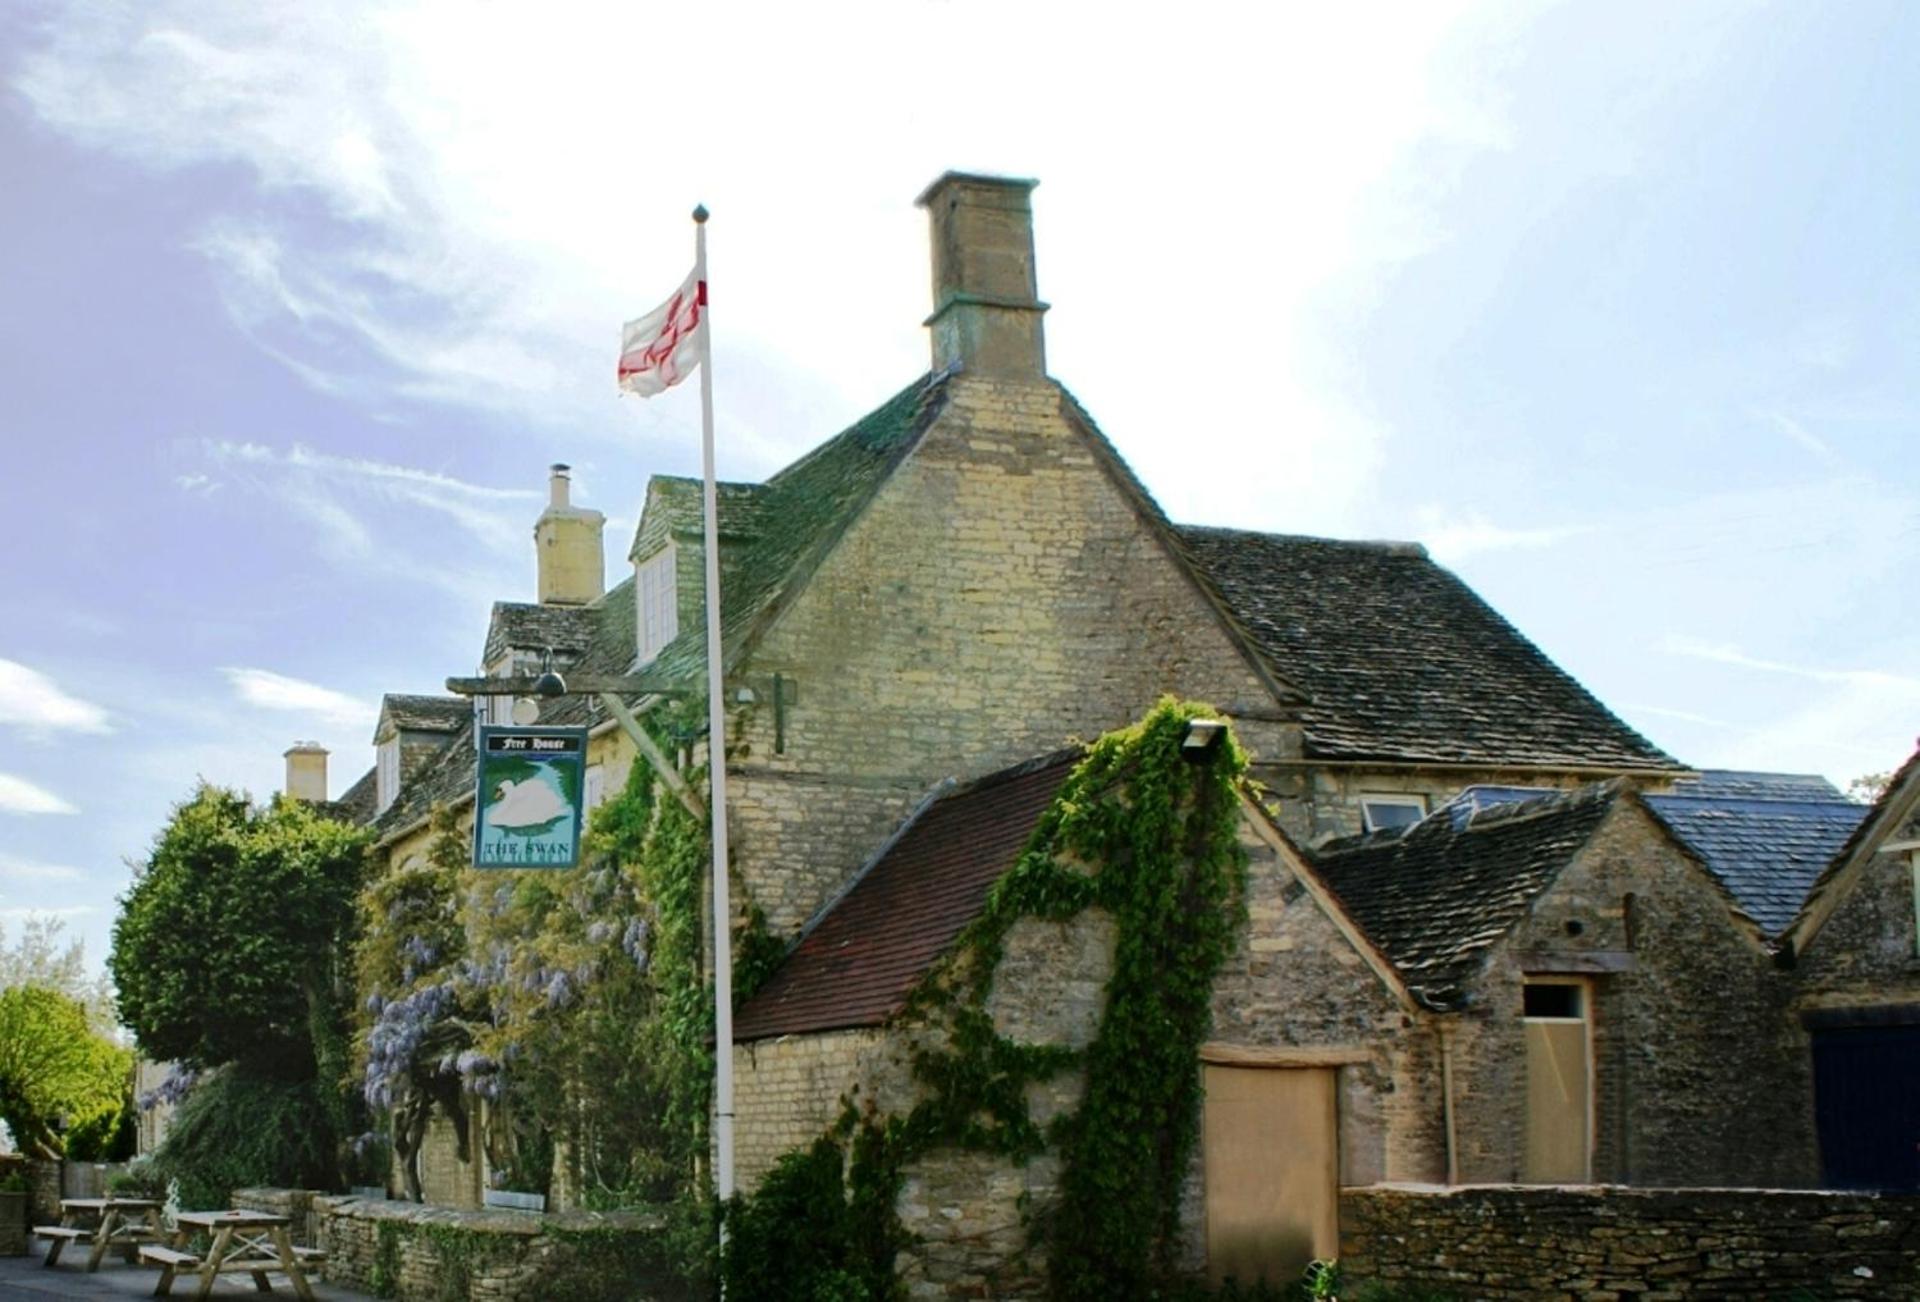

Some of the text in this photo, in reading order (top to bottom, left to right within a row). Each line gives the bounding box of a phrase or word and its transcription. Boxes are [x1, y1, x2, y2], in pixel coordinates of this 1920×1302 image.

[502, 738, 565, 751] Free House
[485, 842, 569, 855] THE SWAN
